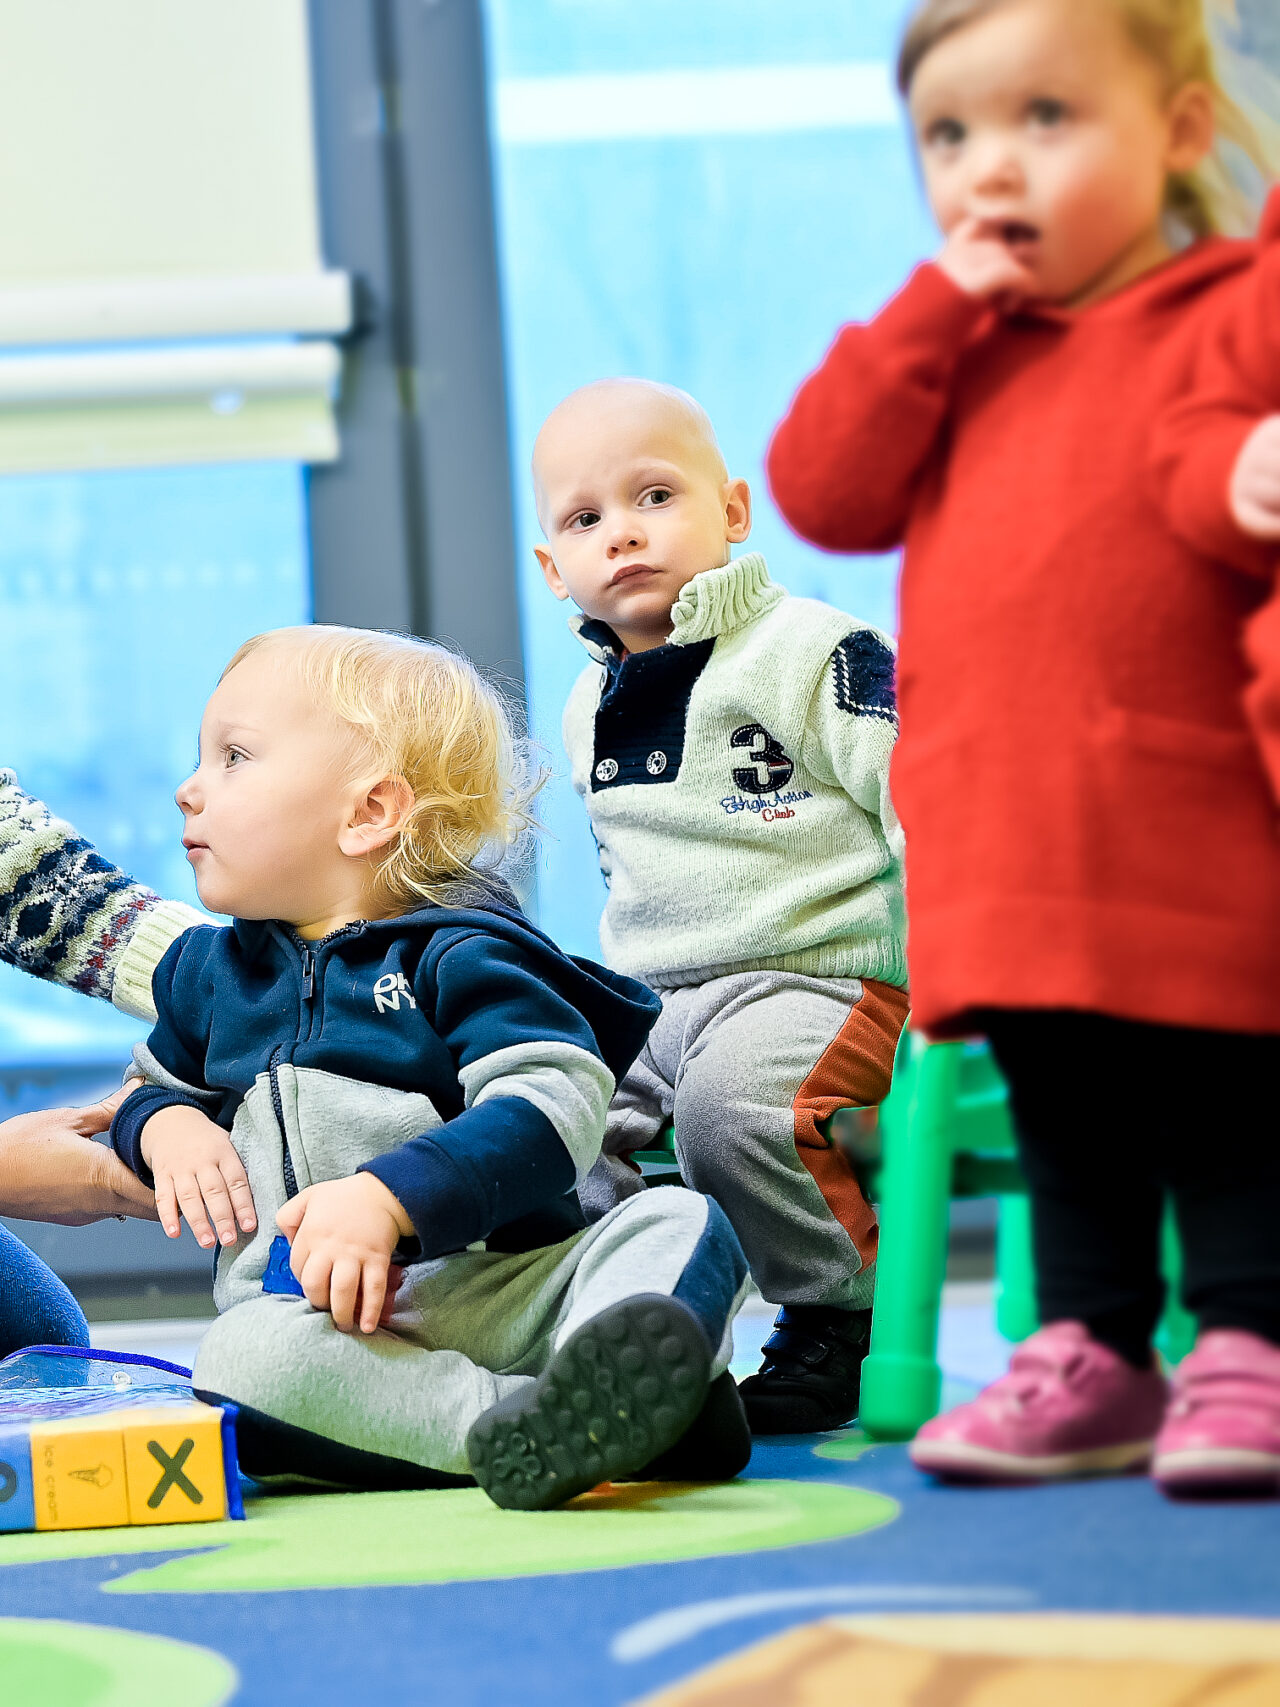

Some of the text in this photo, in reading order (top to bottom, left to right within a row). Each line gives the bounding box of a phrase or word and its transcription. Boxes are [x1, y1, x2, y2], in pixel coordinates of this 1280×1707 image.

[731, 724, 794, 794] 3
[761, 807, 796, 822] Club
[146, 1438, 204, 1508] X
